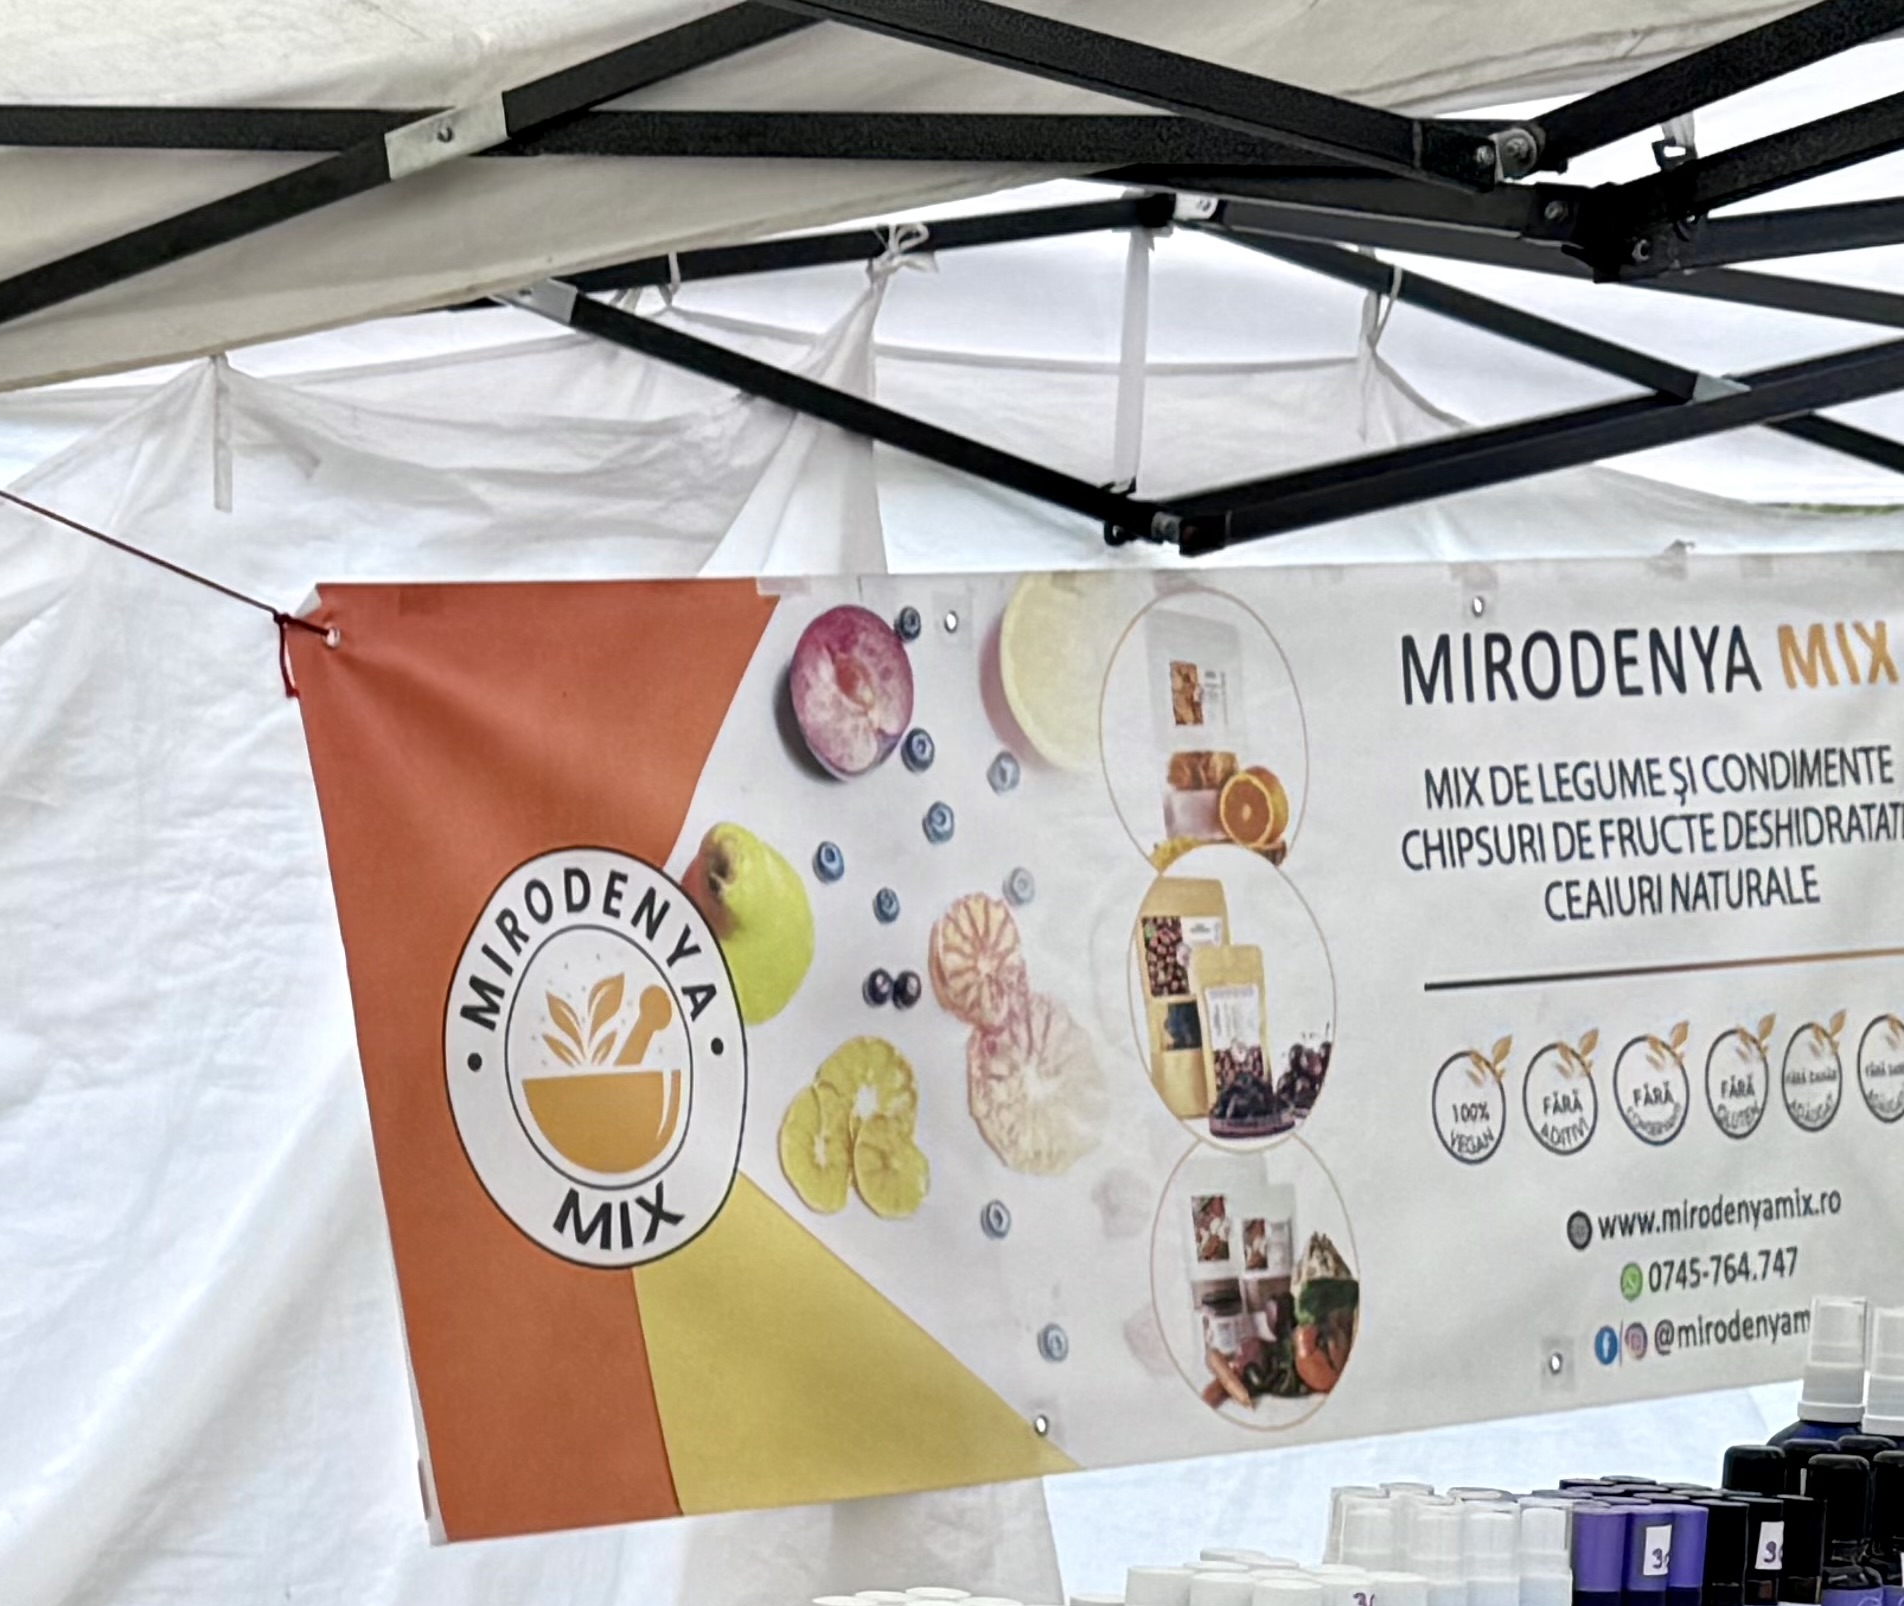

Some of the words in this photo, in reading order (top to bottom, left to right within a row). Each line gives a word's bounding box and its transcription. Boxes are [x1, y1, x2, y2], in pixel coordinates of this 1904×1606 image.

[1401, 625, 1763, 705] MIRODENYA
[1777, 620, 1899, 690] MIX
[1424, 766, 1485, 810] MIX
[1490, 764, 1533, 807] DE
[1538, 757, 1667, 804] LEGUME
[1702, 745, 1894, 795] CONDIMENTE
[1401, 822, 1546, 872] CHIPSURI
[1554, 819, 1596, 862] DE
[1601, 812, 1717, 860] FRUCTE
[1723, 801, 1904, 852] DESHIDRATAT
[1544, 872, 1664, 922] CEAIURI
[1670, 864, 1821, 915] NATURALE
[460, 867, 717, 1032] MIRODENYA
[1450, 1127, 1495, 1156] VEGAN
[1452, 1100, 1490, 1123] 100%
[553, 1180, 685, 1251] MIX
[1597, 1188, 1842, 1241] www.mirodenyamix.ro
[1647, 1246, 1799, 1293] 0745-764.747
